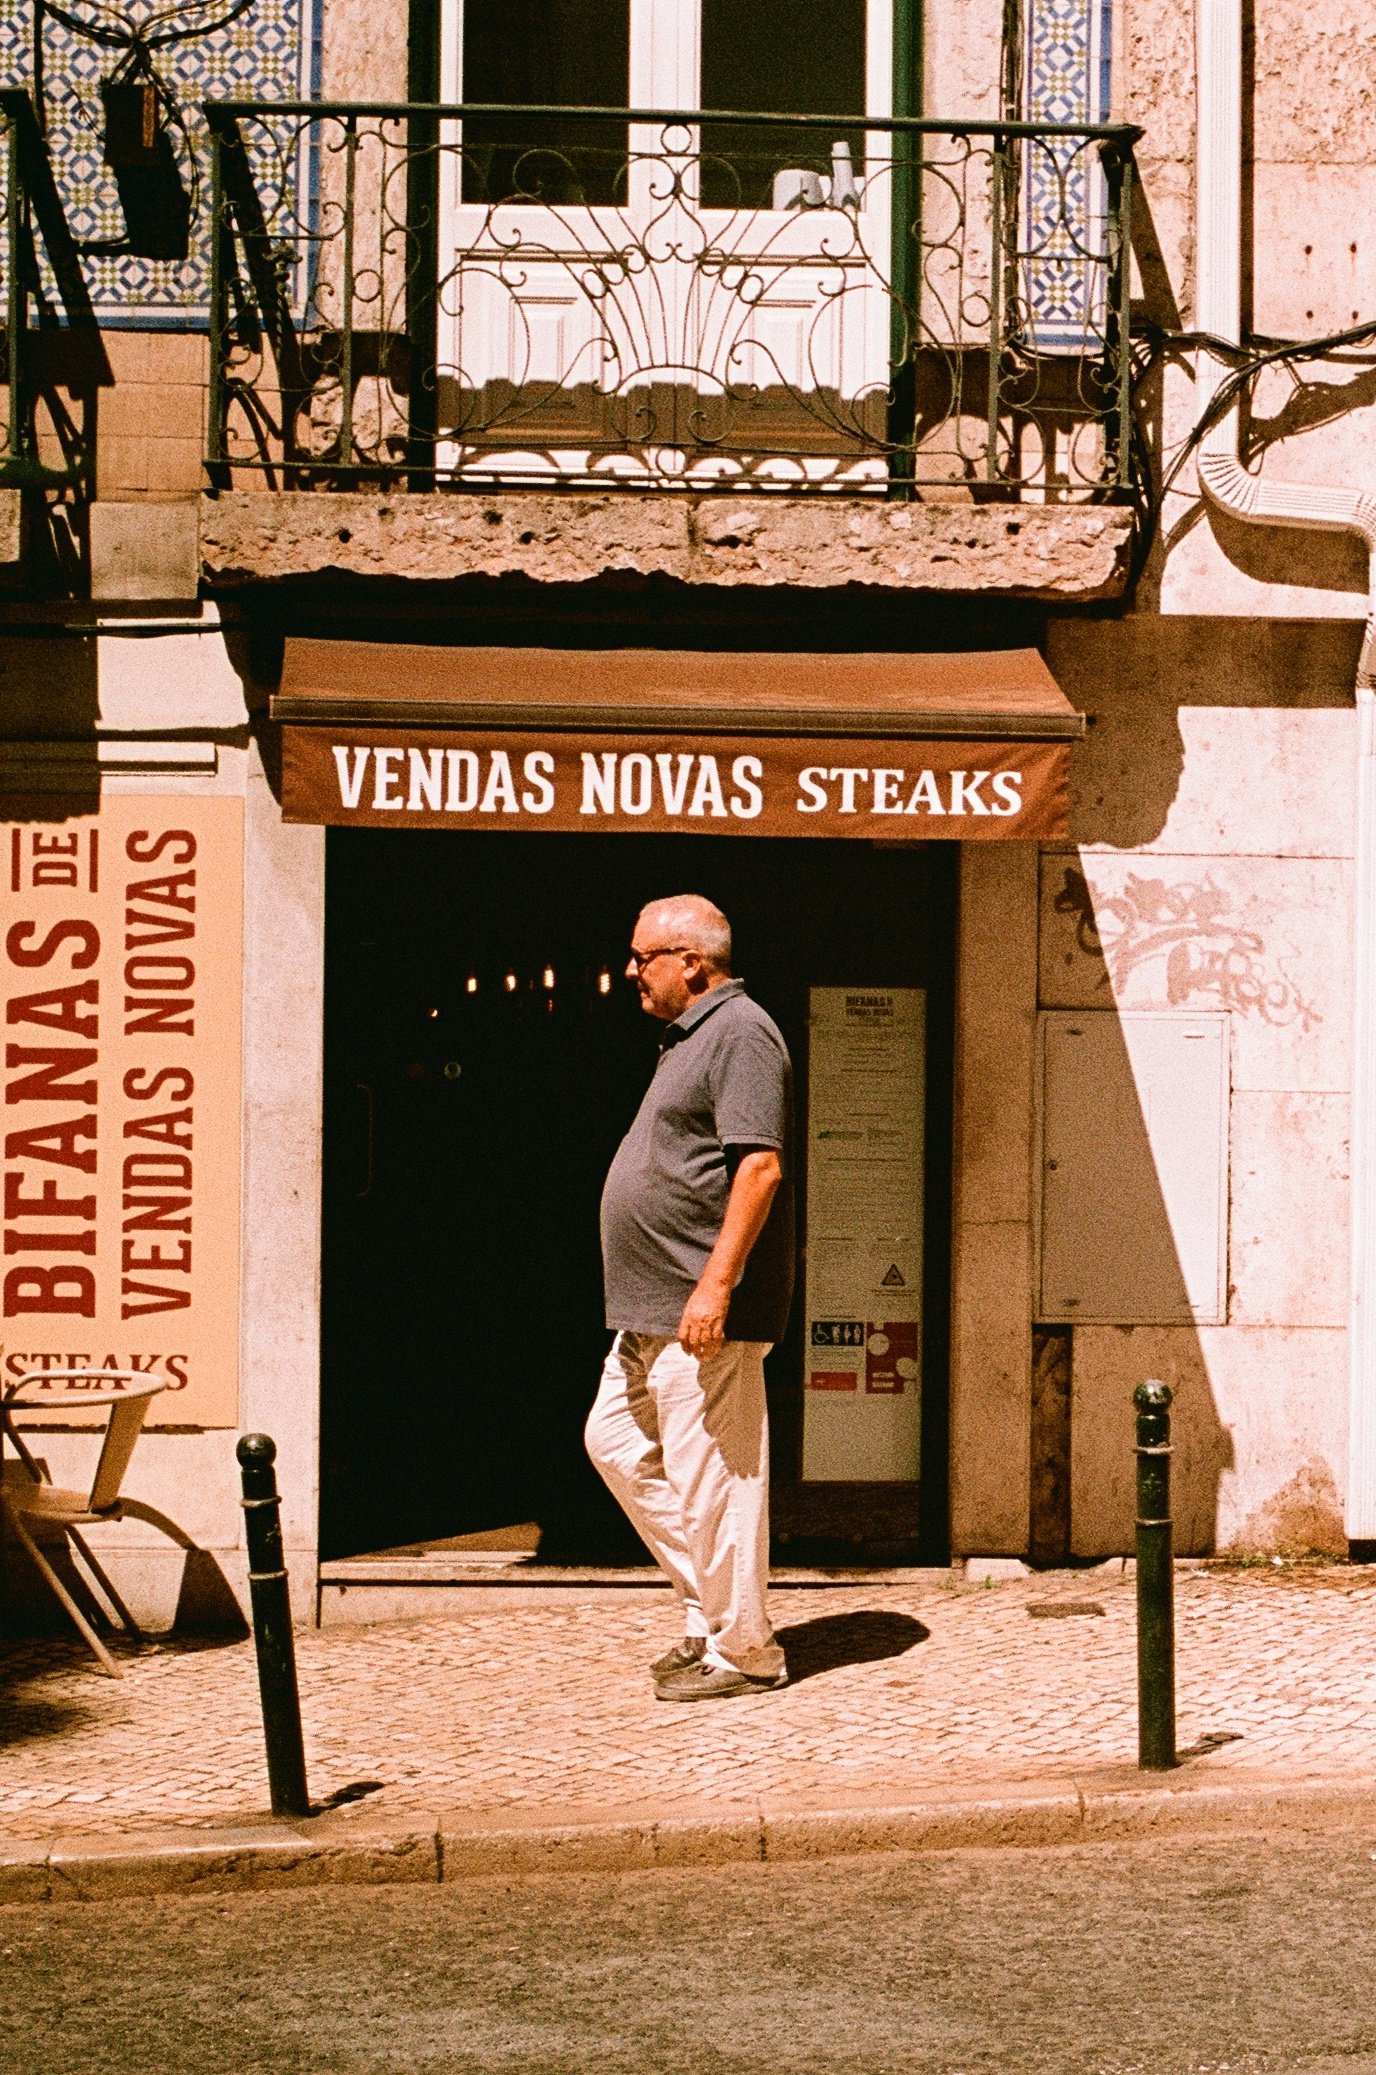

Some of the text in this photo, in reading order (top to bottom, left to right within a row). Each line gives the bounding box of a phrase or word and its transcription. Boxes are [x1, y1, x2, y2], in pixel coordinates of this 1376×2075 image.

[332, 746, 1022, 819] VENDAS NOVAS STEAKS
[3, 832, 101, 1319] BIFANAS DE
[121, 829, 197, 1320] VENDAS NOVAS
